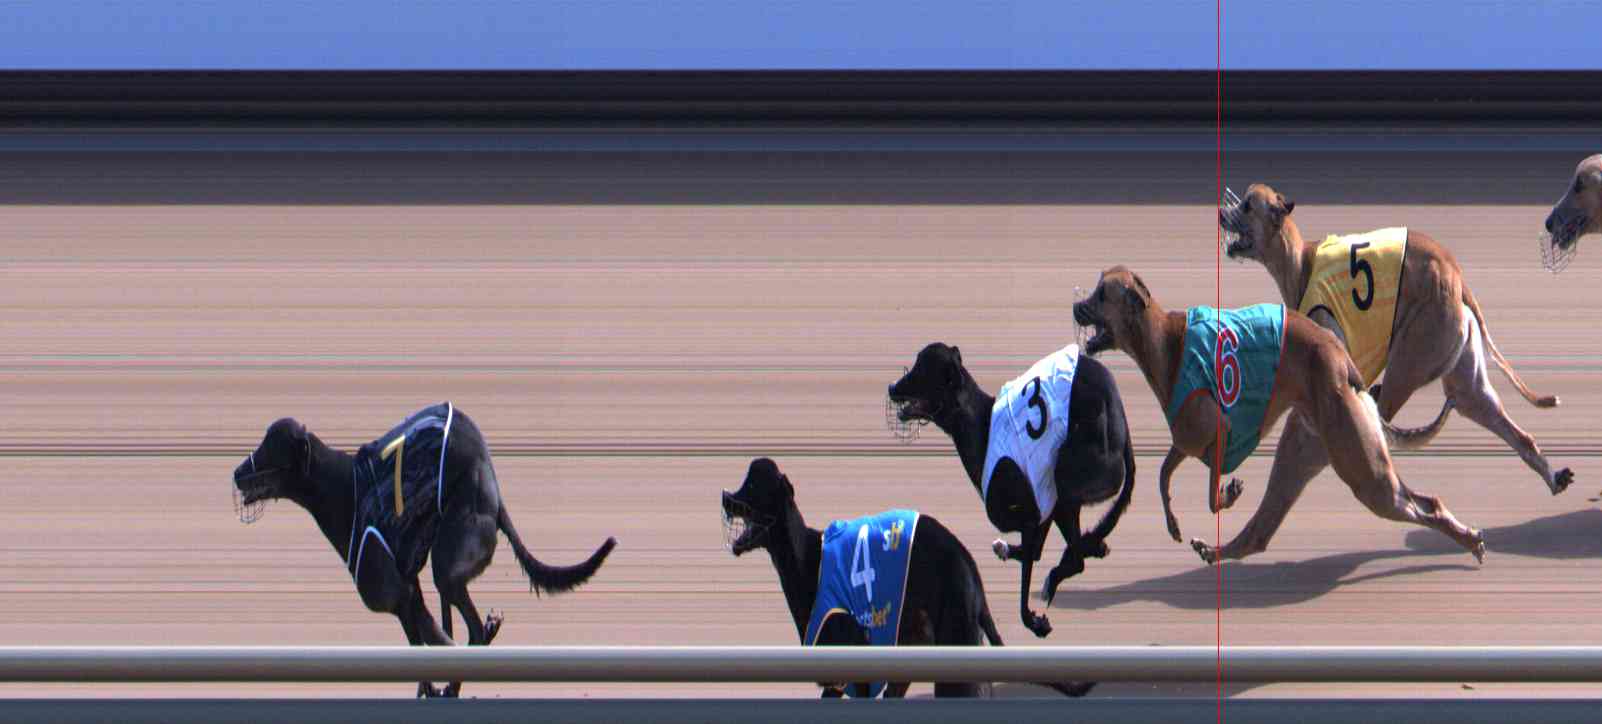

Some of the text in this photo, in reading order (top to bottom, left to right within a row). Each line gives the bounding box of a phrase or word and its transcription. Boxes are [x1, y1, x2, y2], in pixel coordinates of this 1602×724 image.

[1351, 241, 1374, 311] 5
[1215, 327, 1241, 408] 6
[1022, 376, 1048, 440] 3
[381, 434, 406, 516] 7
[851, 524, 876, 603] 4
